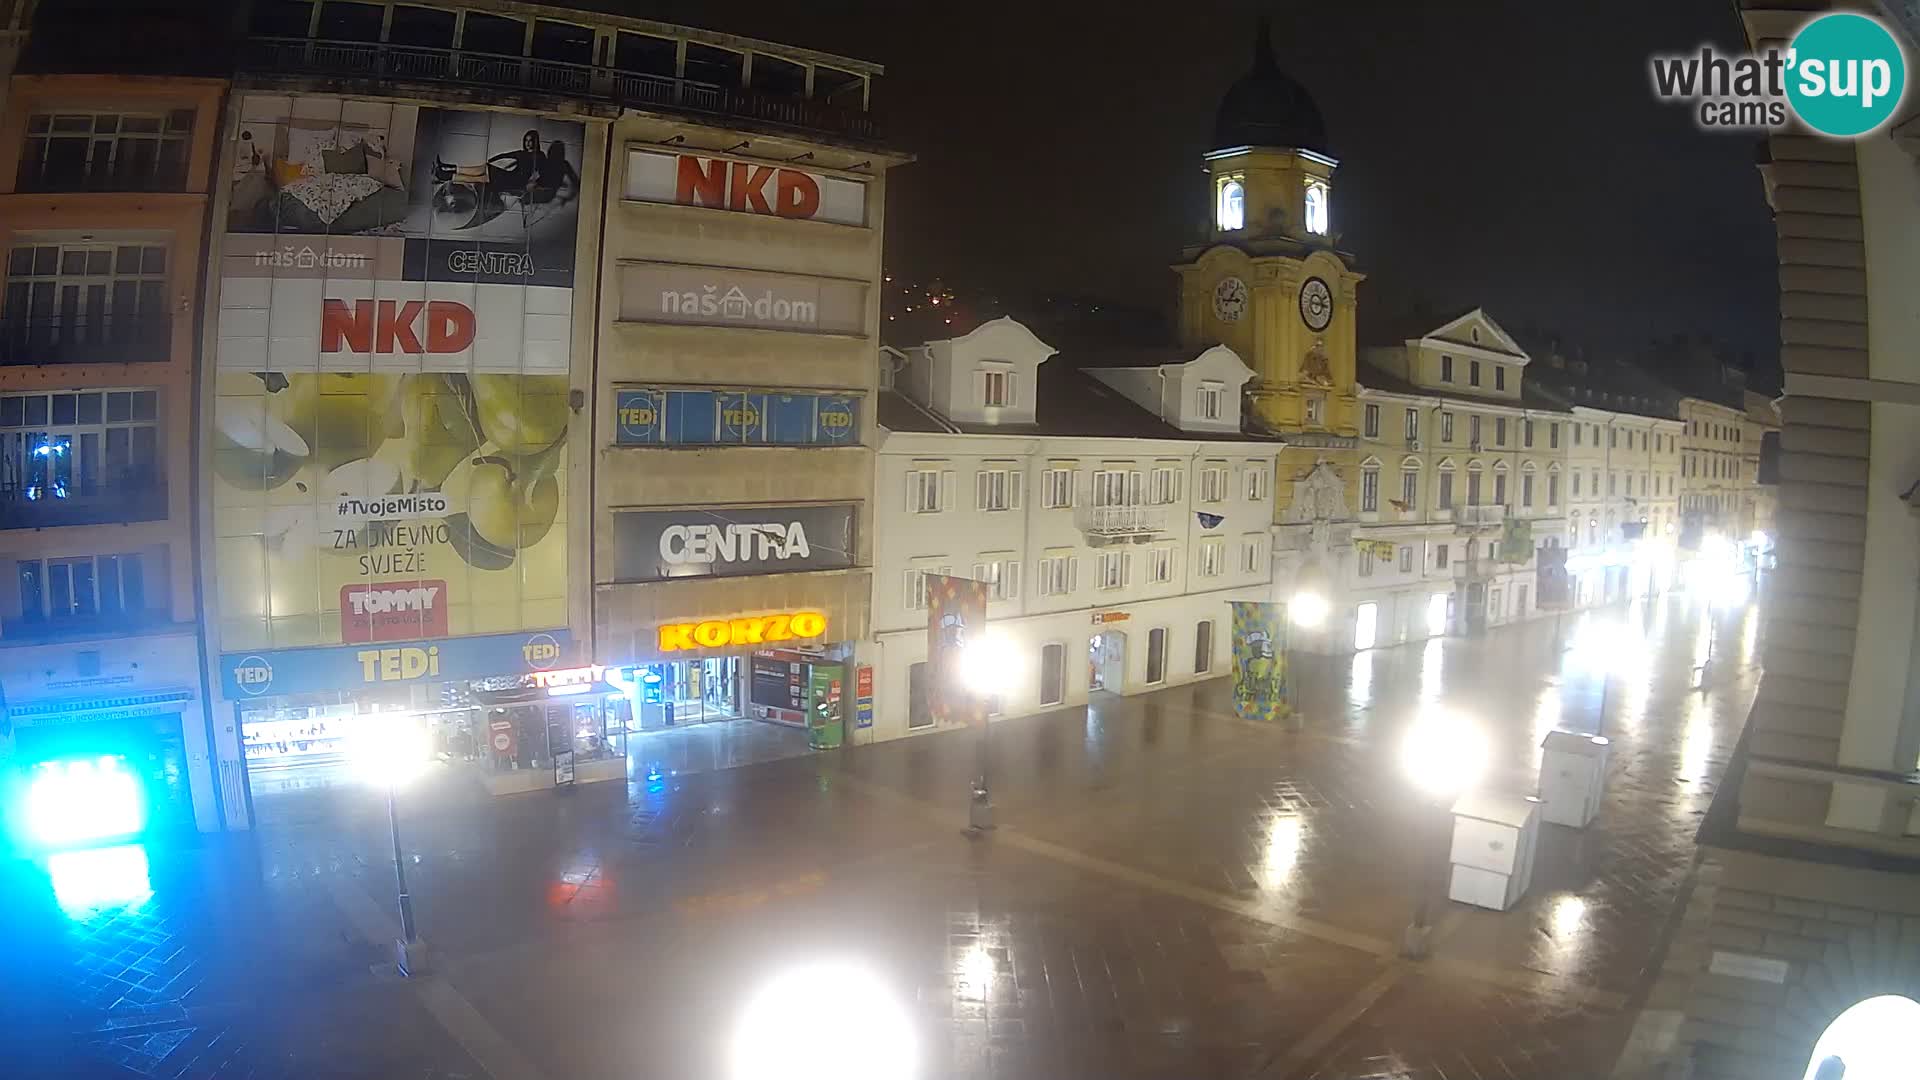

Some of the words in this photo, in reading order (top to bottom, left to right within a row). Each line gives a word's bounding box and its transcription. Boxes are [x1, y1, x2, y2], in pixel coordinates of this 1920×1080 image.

[675, 155, 820, 219] NKD
[255, 246, 296, 269] naš
[319, 247, 365, 270] dom
[448, 250, 535, 277] CENTRA
[661, 285, 717, 317] naš
[754, 291, 817, 323] dom
[321, 298, 476, 354] NKD
[619, 408, 657, 426] TEDi
[724, 409, 760, 426] TEDi
[338, 496, 446, 517] #TvojeMisto
[333, 528, 357, 549] ZA
[368, 523, 452, 549] DNEVNO
[659, 521, 811, 564] CENTRA
[359, 548, 426, 576] SVJEŽE
[348, 586, 439, 614] TOMMY
[659, 612, 822, 651] KORZO
[358, 646, 441, 682] TEDi
[523, 643, 561, 662] TEDi
[234, 666, 272, 684] TEDi
[534, 663, 606, 688] TOMMY
